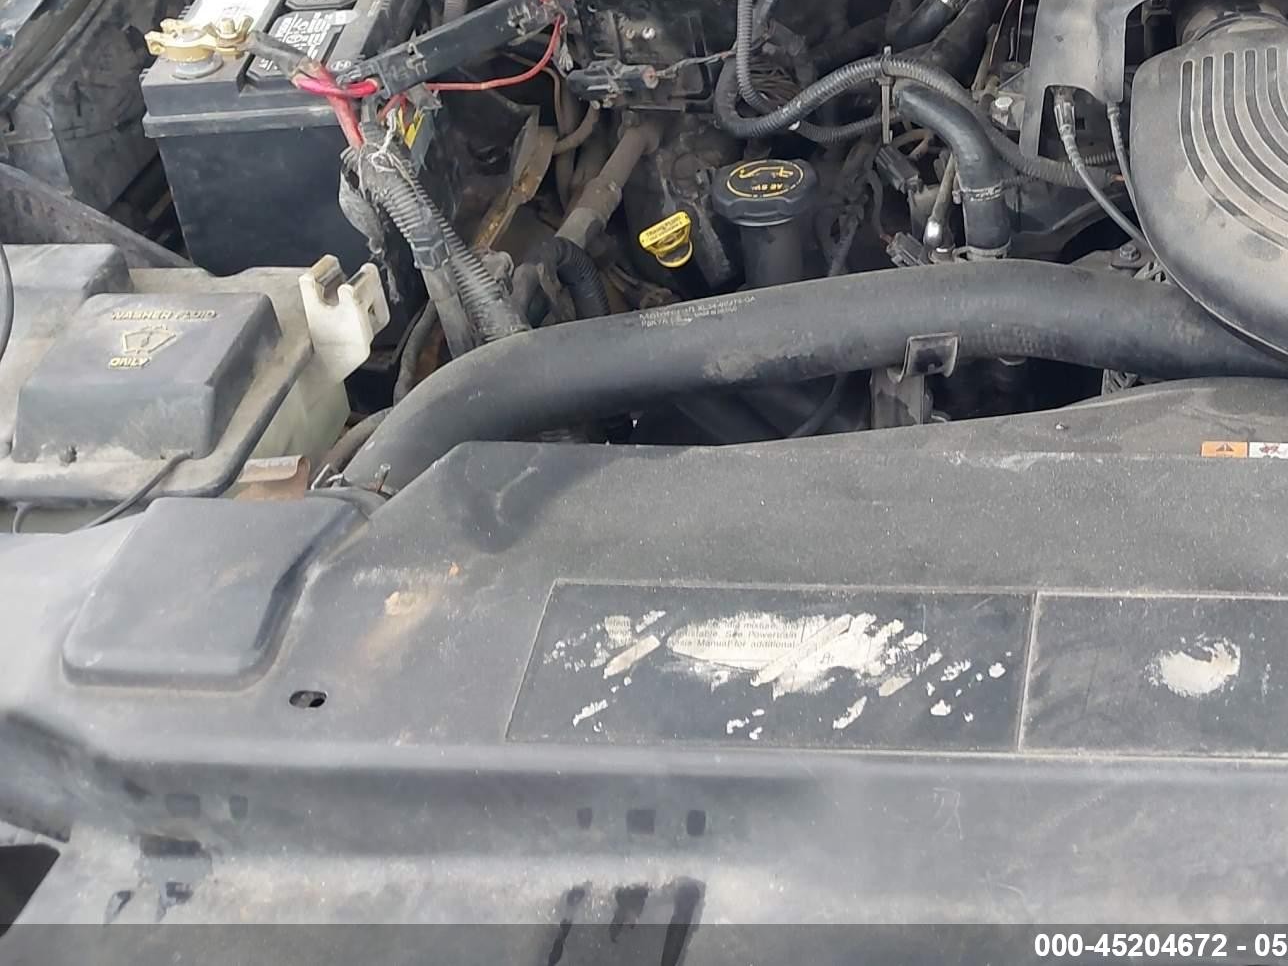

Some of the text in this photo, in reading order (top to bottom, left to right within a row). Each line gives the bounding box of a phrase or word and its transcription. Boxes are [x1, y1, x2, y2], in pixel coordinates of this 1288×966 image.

[112, 309, 217, 321] WASHER FLUID
[110, 356, 151, 368] ONLY
[747, 630, 797, 640] Powertrain
[696, 639, 730, 648] Manual
[750, 639, 795, 649] additional
